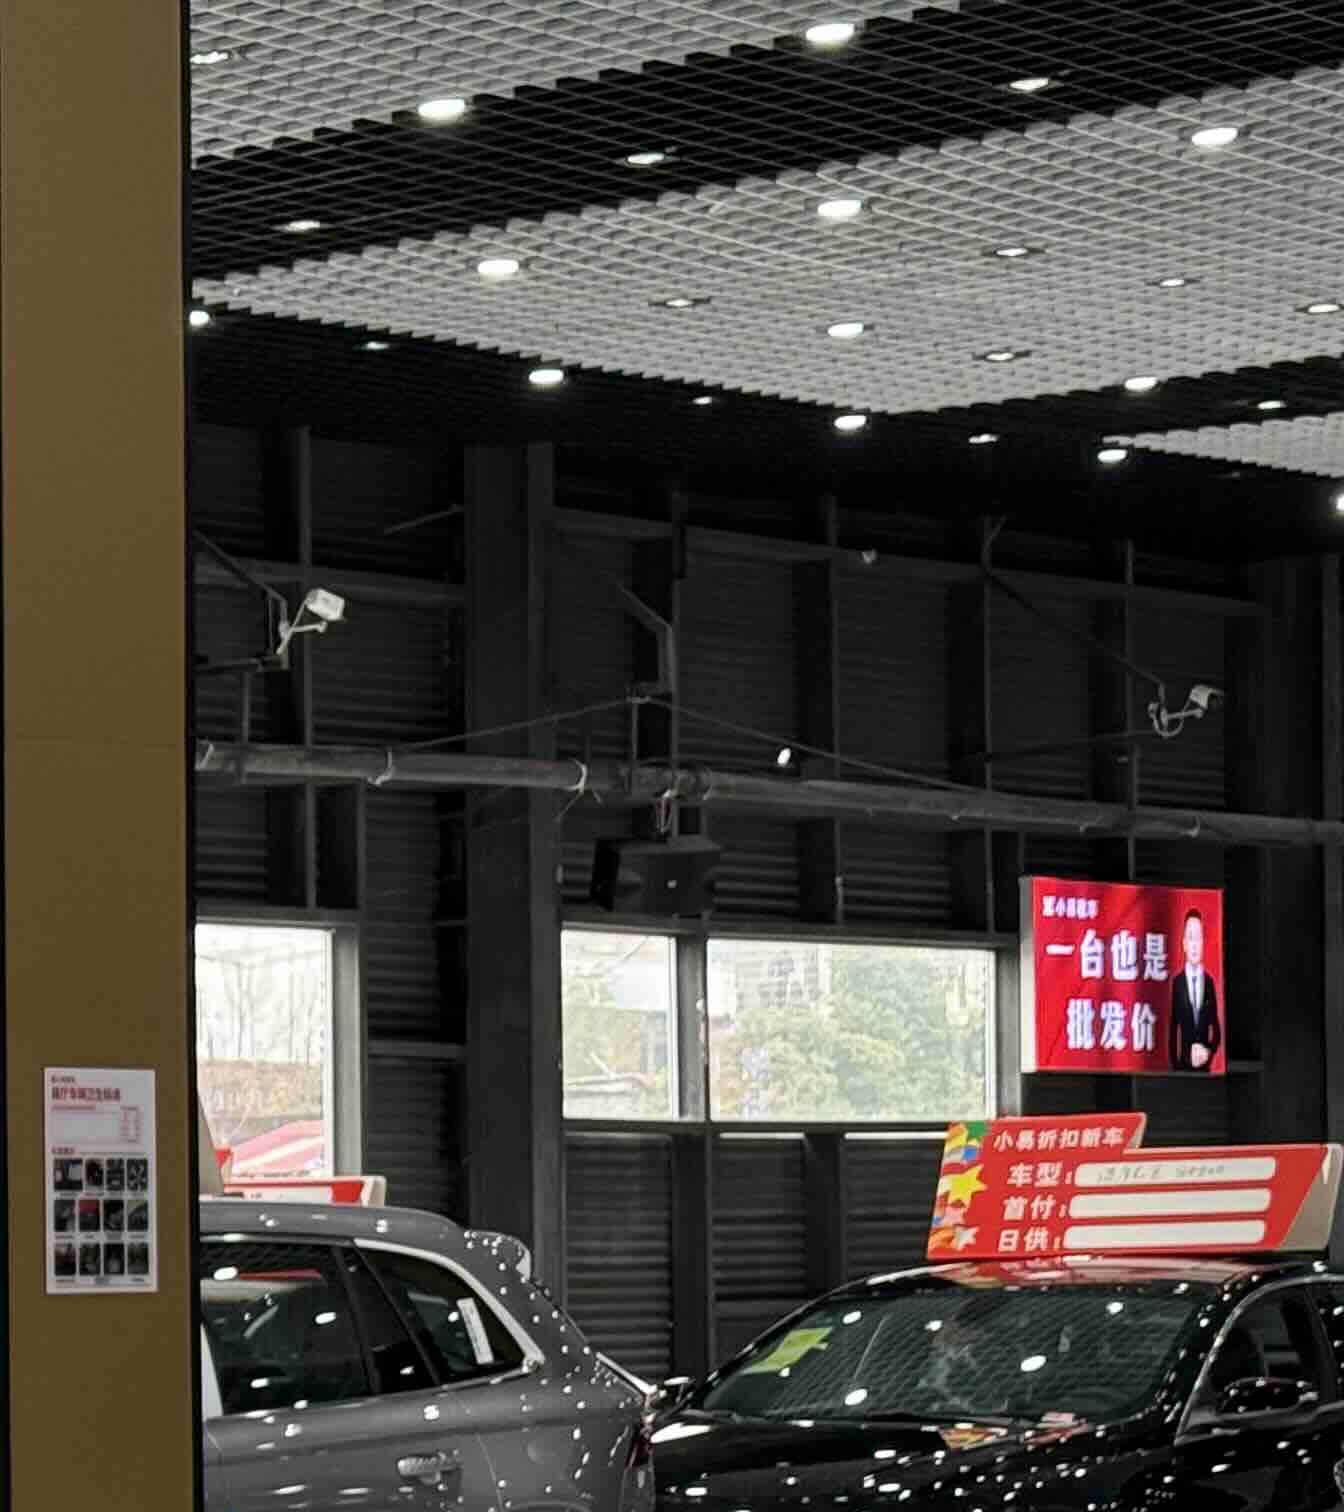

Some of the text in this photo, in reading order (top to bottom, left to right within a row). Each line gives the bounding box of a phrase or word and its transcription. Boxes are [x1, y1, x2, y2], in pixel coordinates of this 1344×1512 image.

[1045, 928, 1169, 982] 一台也是
[1066, 998, 1158, 1053] 批发价
[993, 1126, 1126, 1153] 小易折扣新车
